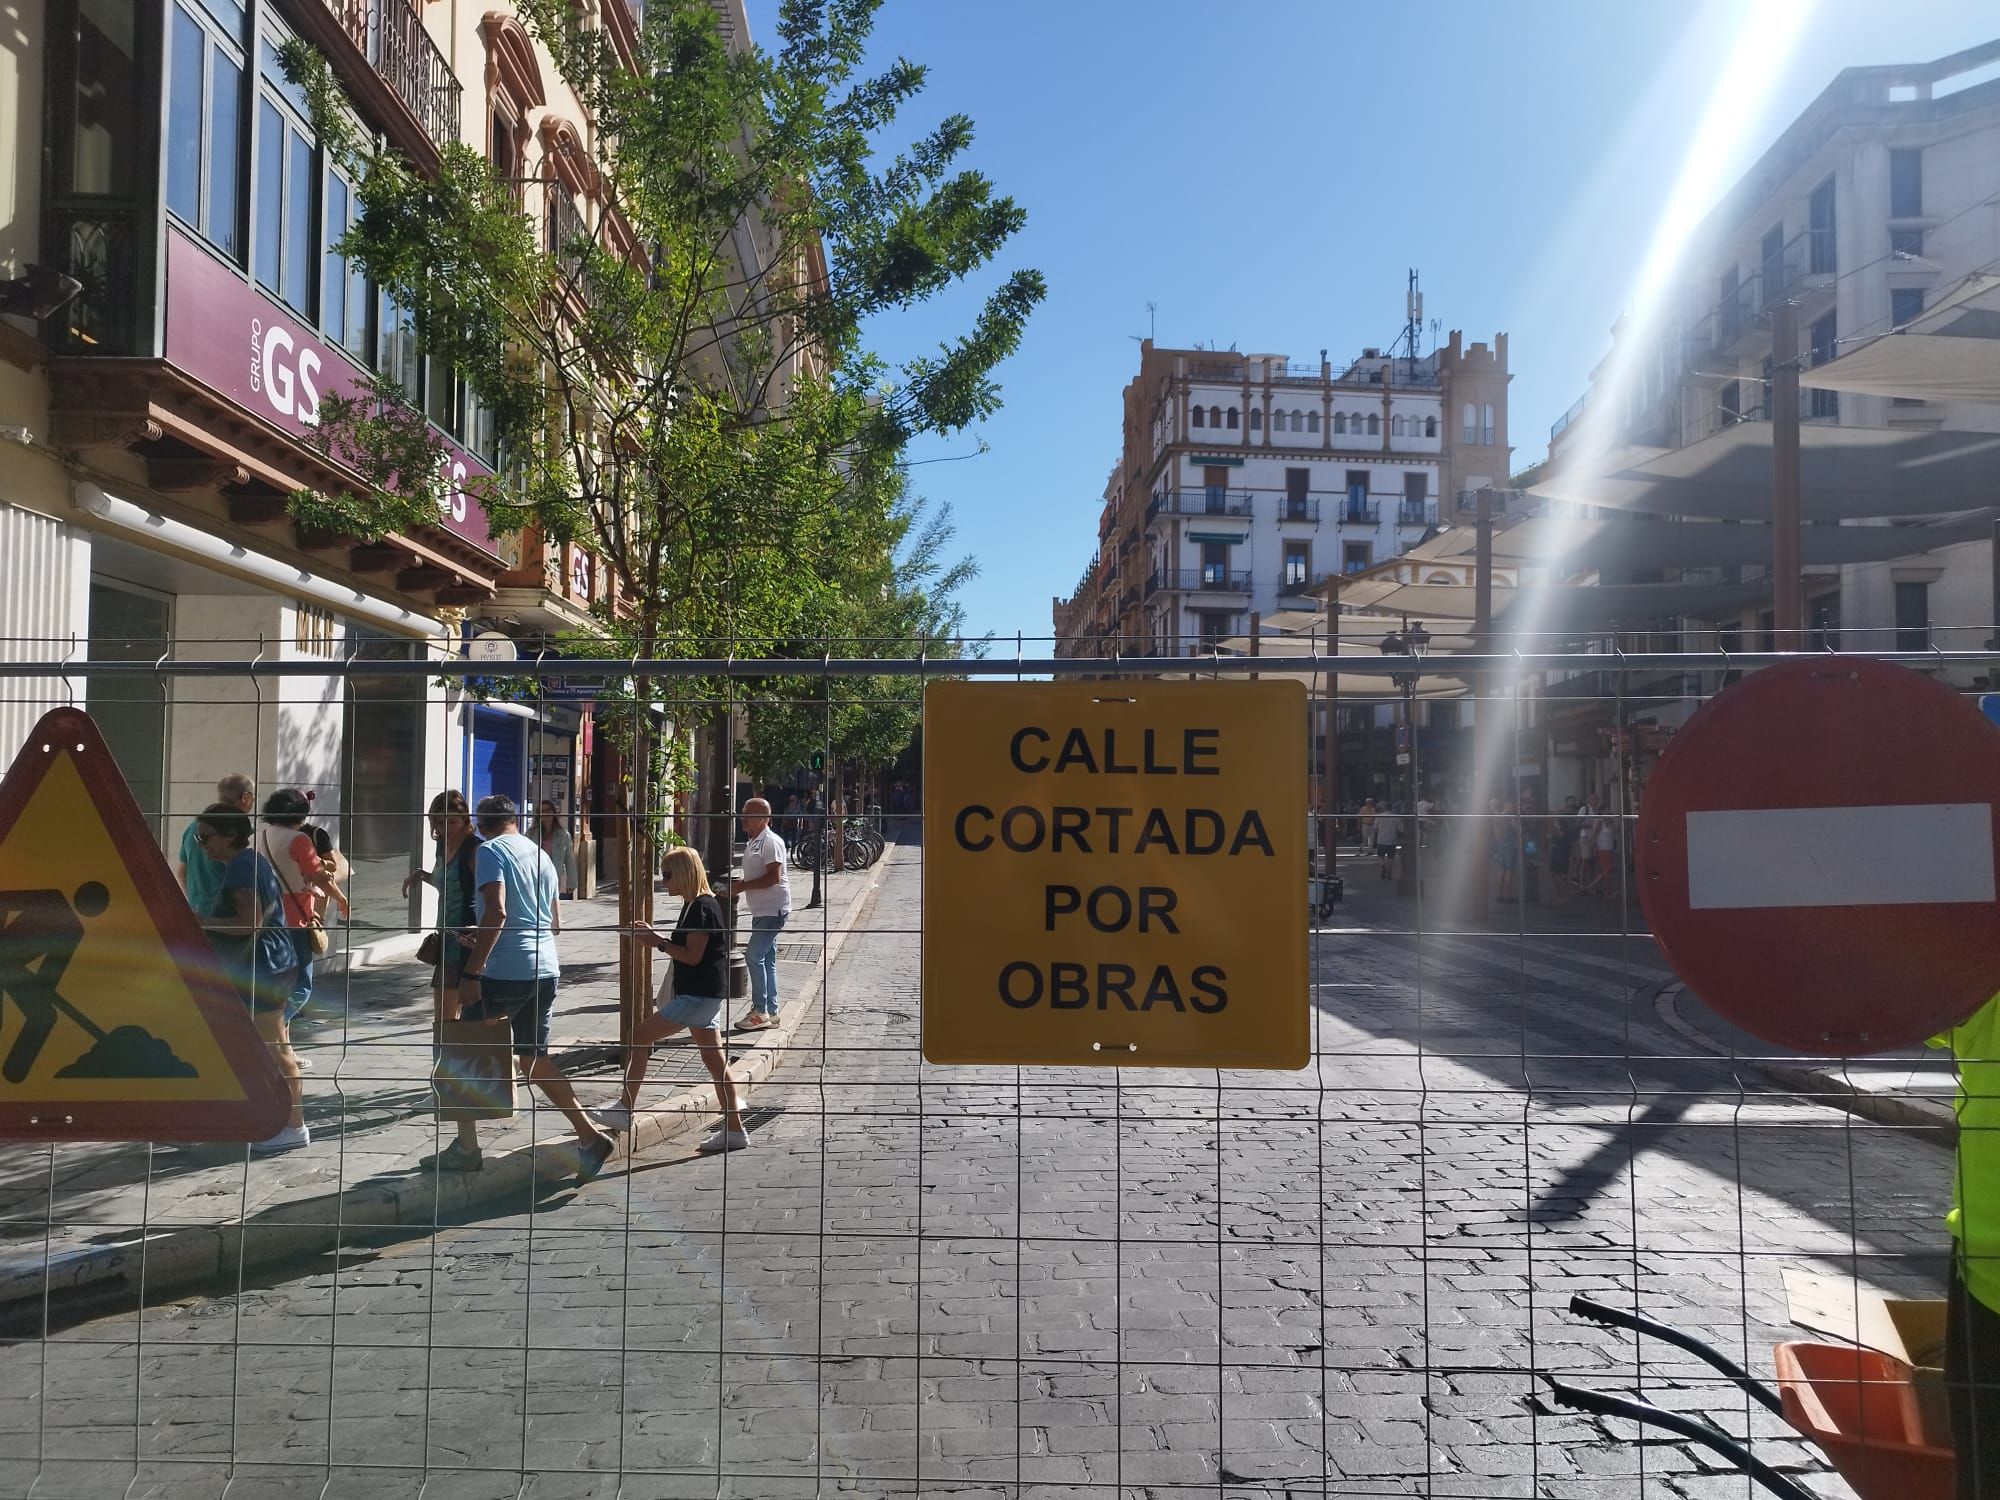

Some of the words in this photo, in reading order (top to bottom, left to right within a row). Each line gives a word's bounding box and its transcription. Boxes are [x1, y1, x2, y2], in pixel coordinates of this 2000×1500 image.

[250, 318, 261, 392] GRUPO
[263, 326, 322, 426] GS
[573, 547, 589, 599] GS
[1010, 726, 1220, 776] CALLE
[954, 805, 1276, 857] CORTADA
[1045, 885, 1181, 934] POR
[999, 961, 1229, 1014] OBRAS
